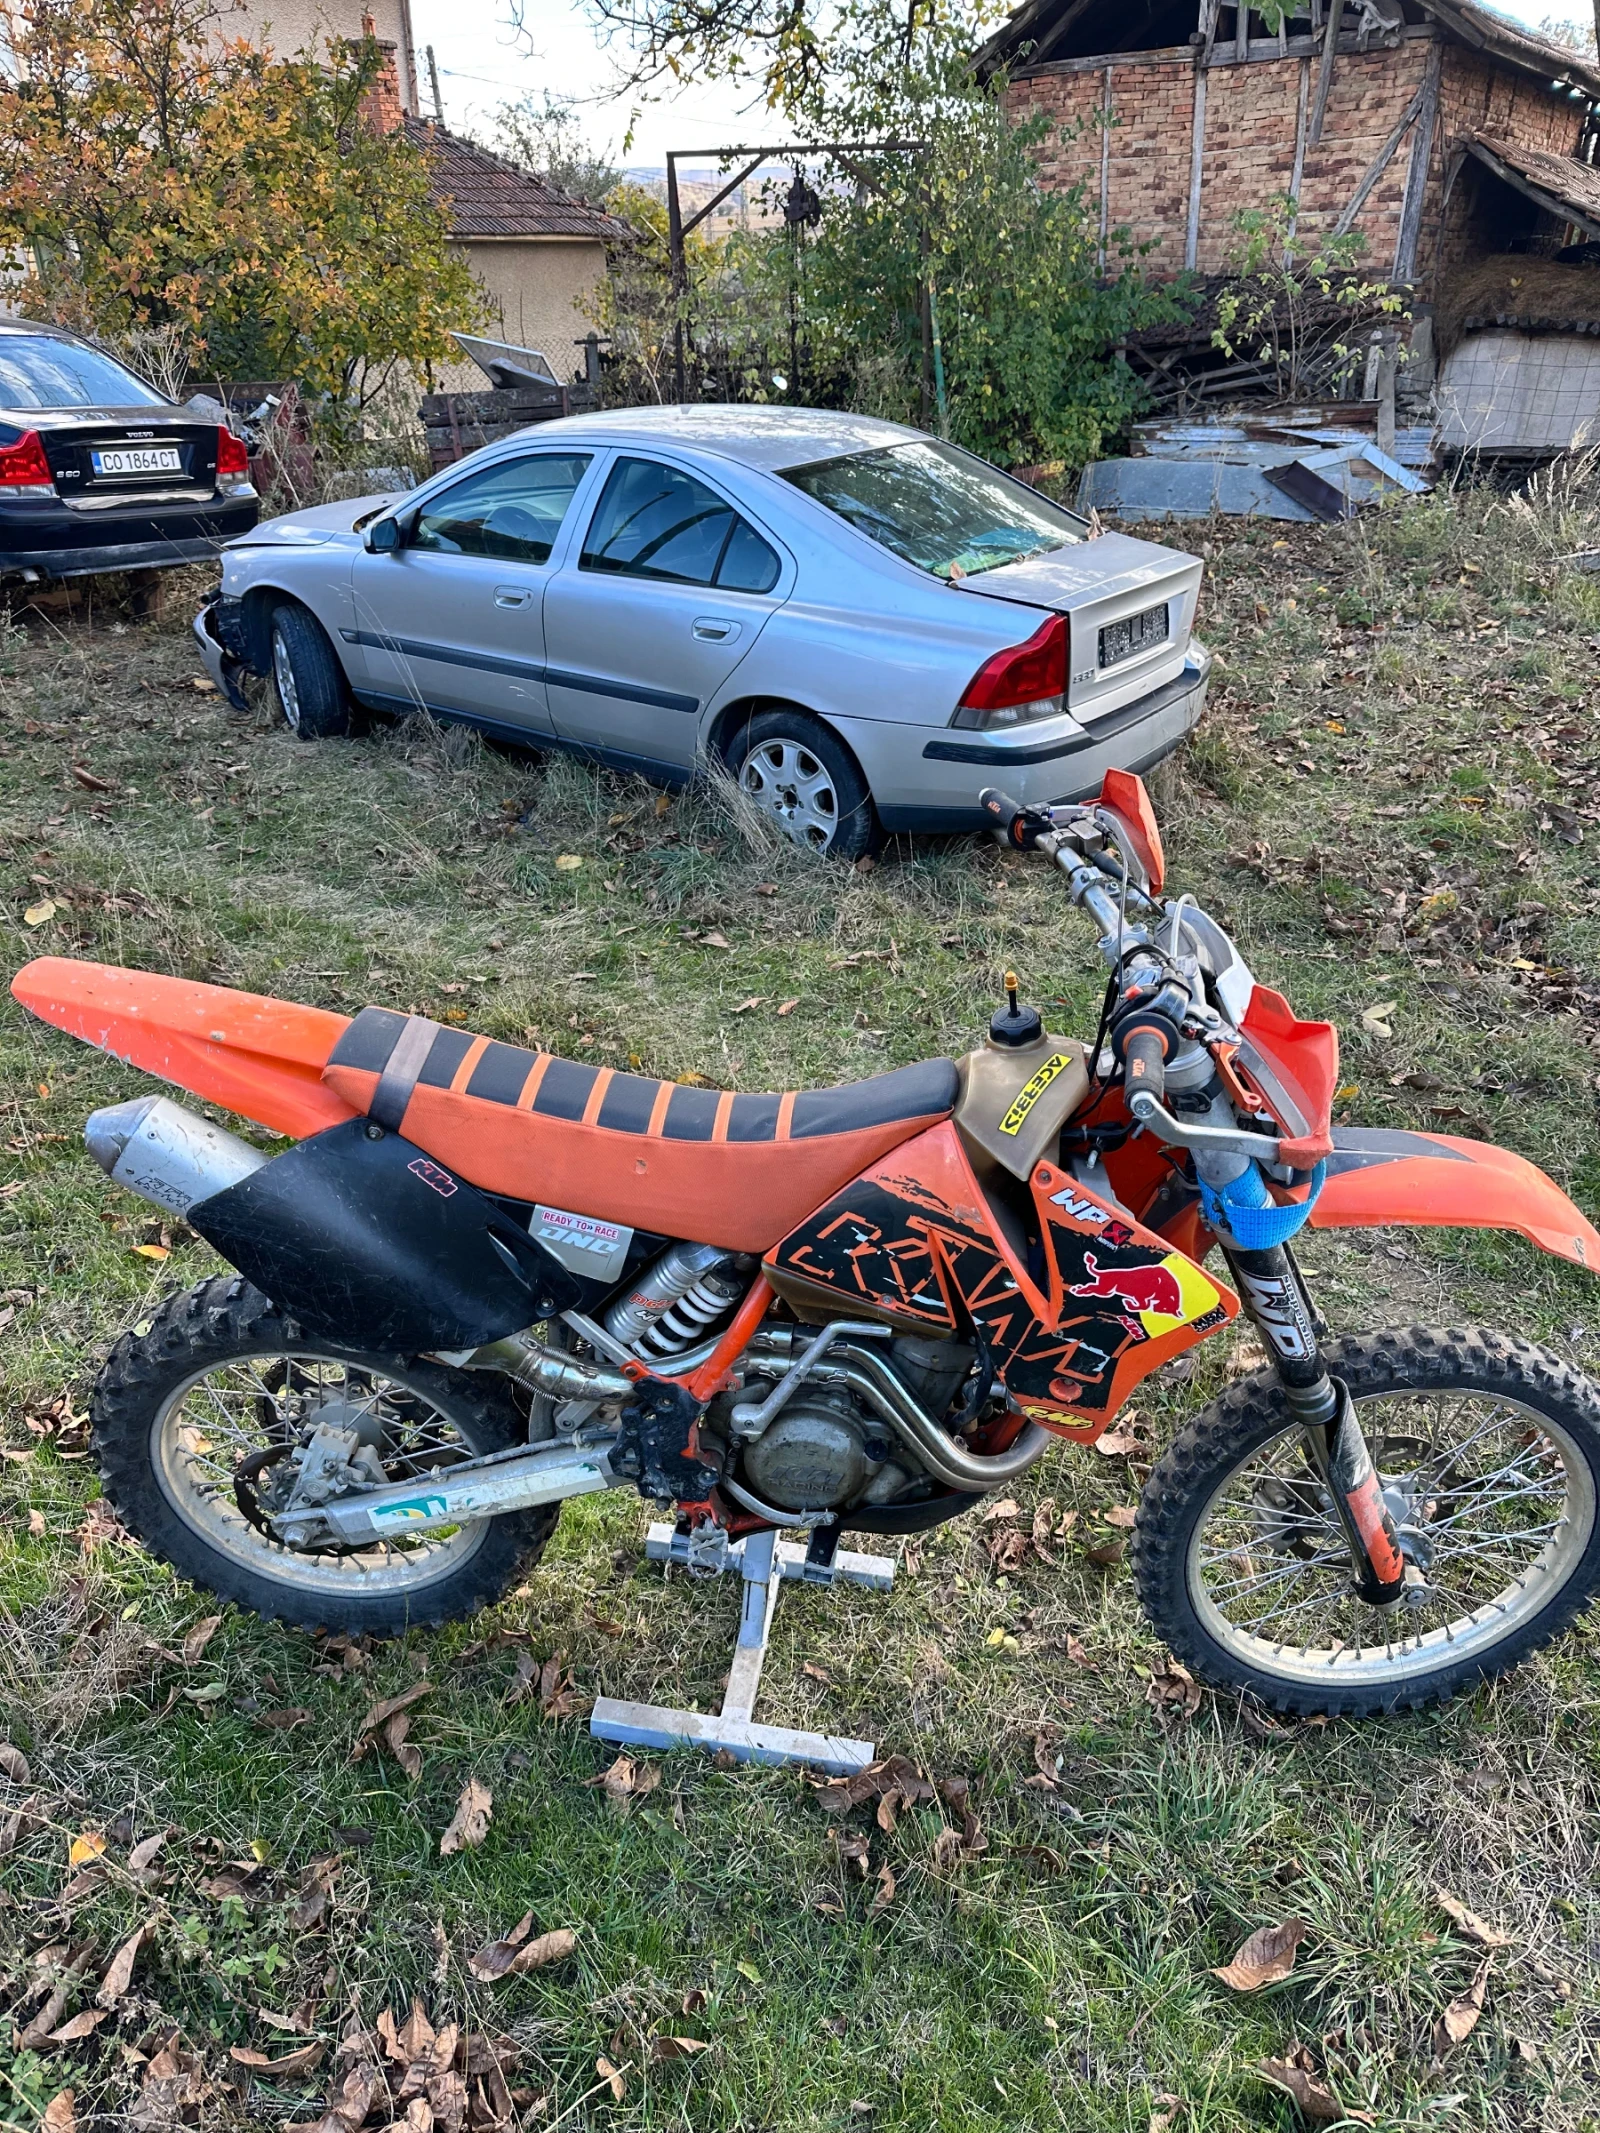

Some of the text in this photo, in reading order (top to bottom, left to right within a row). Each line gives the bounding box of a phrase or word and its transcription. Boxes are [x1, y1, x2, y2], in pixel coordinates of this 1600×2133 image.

[103, 454, 123, 471] CO
[126, 451, 157, 470] 1864
[160, 451, 176, 468] CT
[408, 1158, 458, 1197] KTM
[1048, 1187, 1112, 1225] WP
[543, 1212, 572, 1226] READY
[594, 1225, 618, 1239] RACE
[1117, 1314, 1146, 1341] KTM
[1281, 1274, 1317, 1357] suspension
